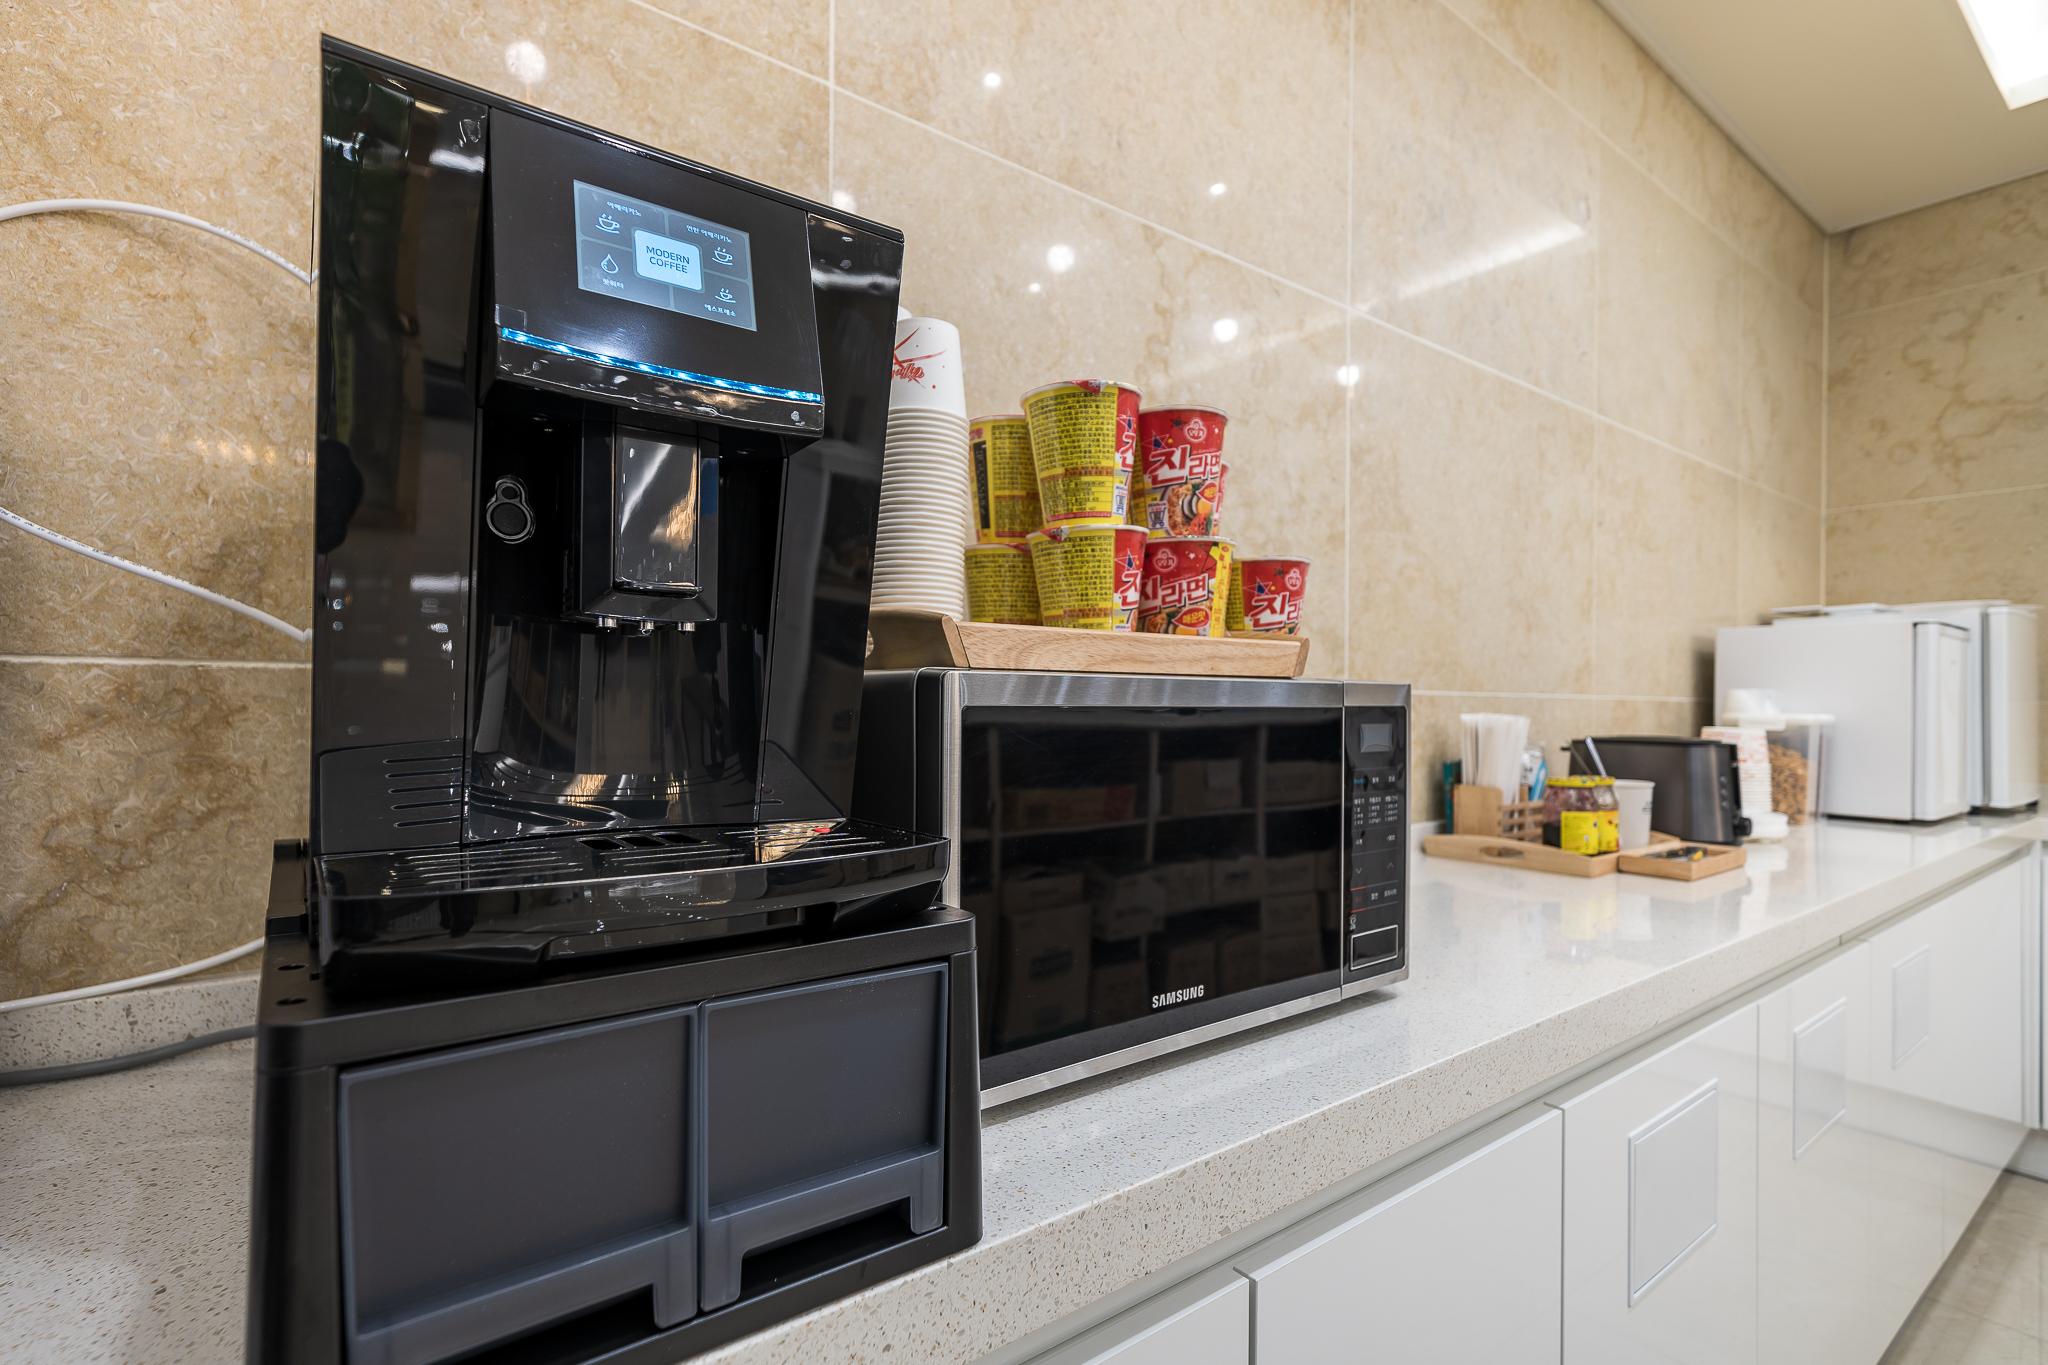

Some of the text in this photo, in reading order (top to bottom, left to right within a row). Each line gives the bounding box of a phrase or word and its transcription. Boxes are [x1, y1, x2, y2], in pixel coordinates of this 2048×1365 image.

[645, 245, 691, 265] MODERN
[649, 256, 688, 274] COFFEE
[1151, 984, 1205, 1009] SAMSUNG
